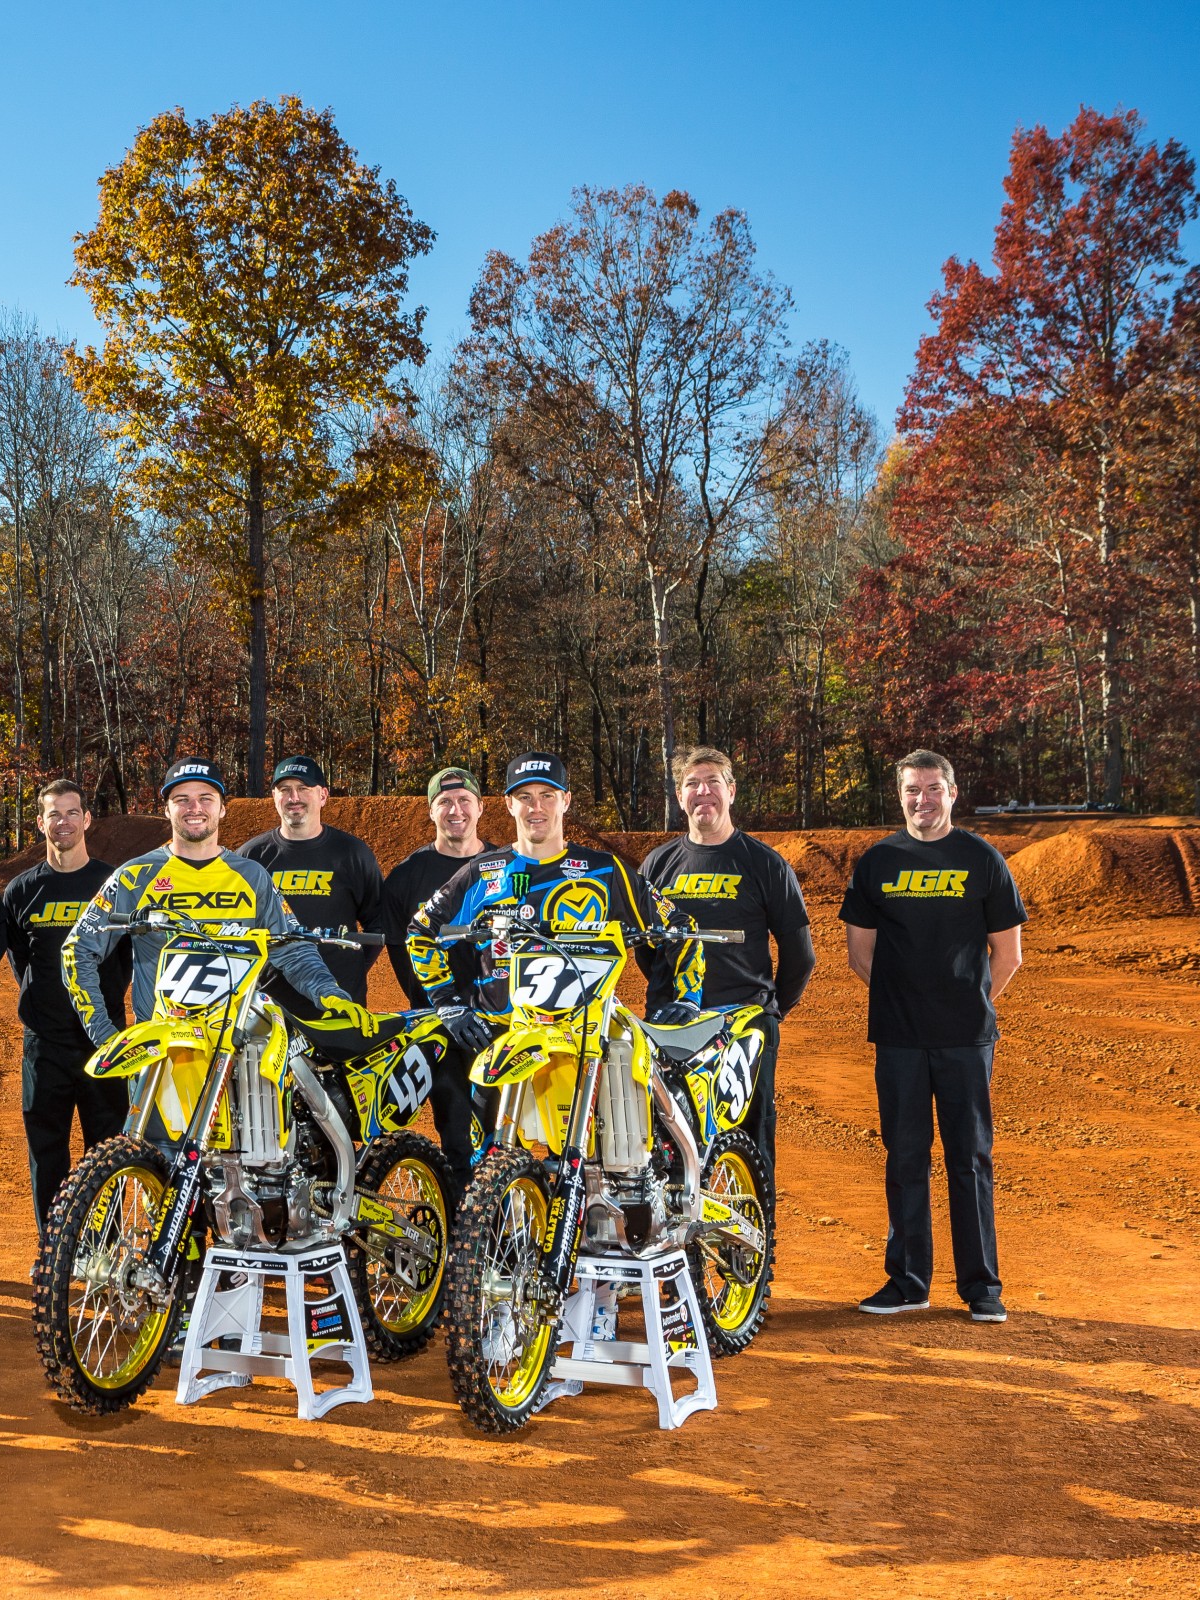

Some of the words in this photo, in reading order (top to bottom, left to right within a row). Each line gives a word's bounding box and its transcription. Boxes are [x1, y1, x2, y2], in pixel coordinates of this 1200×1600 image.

[174, 763, 210, 778] JGR
[280, 764, 308, 773] JGR
[515, 760, 551, 774] JGR
[562, 860, 587, 868] AMA
[661, 873, 742, 896] JGR
[881, 869, 969, 893] JGR
[942, 890, 965, 898] MX
[29, 901, 89, 923] JG
[155, 954, 251, 1005] 43
[513, 957, 614, 1008] 37
[121, 1052, 150, 1070] Autotrader
[510, 1058, 535, 1077] Autotrader
[387, 1044, 433, 1114] 43
[720, 1029, 760, 1120] 37
[381, 1105, 393, 1120] JGR
[717, 1103, 726, 1120] JGR
[151, 1187, 175, 1241] GALFER
[168, 1179, 189, 1238] DUNLOP
[558, 1198, 566, 1220] USA
[402, 1226, 420, 1243] JGR
[543, 1197, 562, 1253] GALFER
